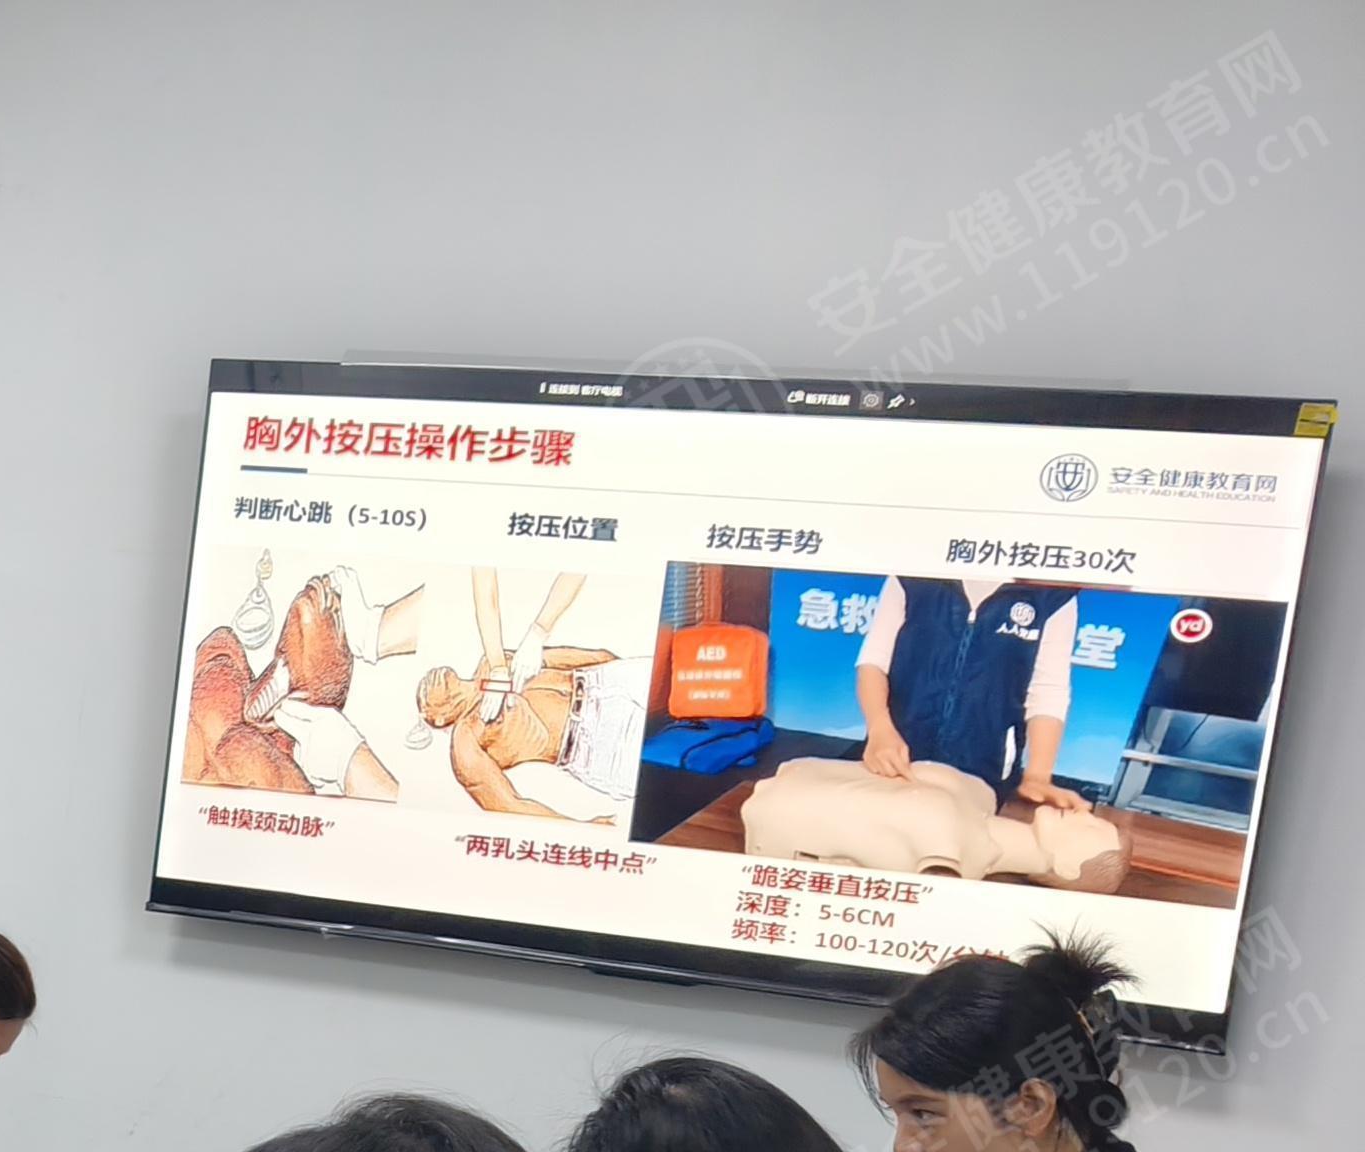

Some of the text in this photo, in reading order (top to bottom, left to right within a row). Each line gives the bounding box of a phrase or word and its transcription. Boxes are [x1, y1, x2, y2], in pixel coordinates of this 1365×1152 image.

[243, 415, 576, 468] 胸外按压操作步骤
[1109, 466, 1279, 494] 安全健康教育网
[506, 511, 620, 543] 按压位置
[705, 523, 823, 556] 按压手势
[946, 538, 1137, 575] 胸外按压30次
[796, 587, 1126, 670] 急救 堂
[696, 644, 727, 662] AED
